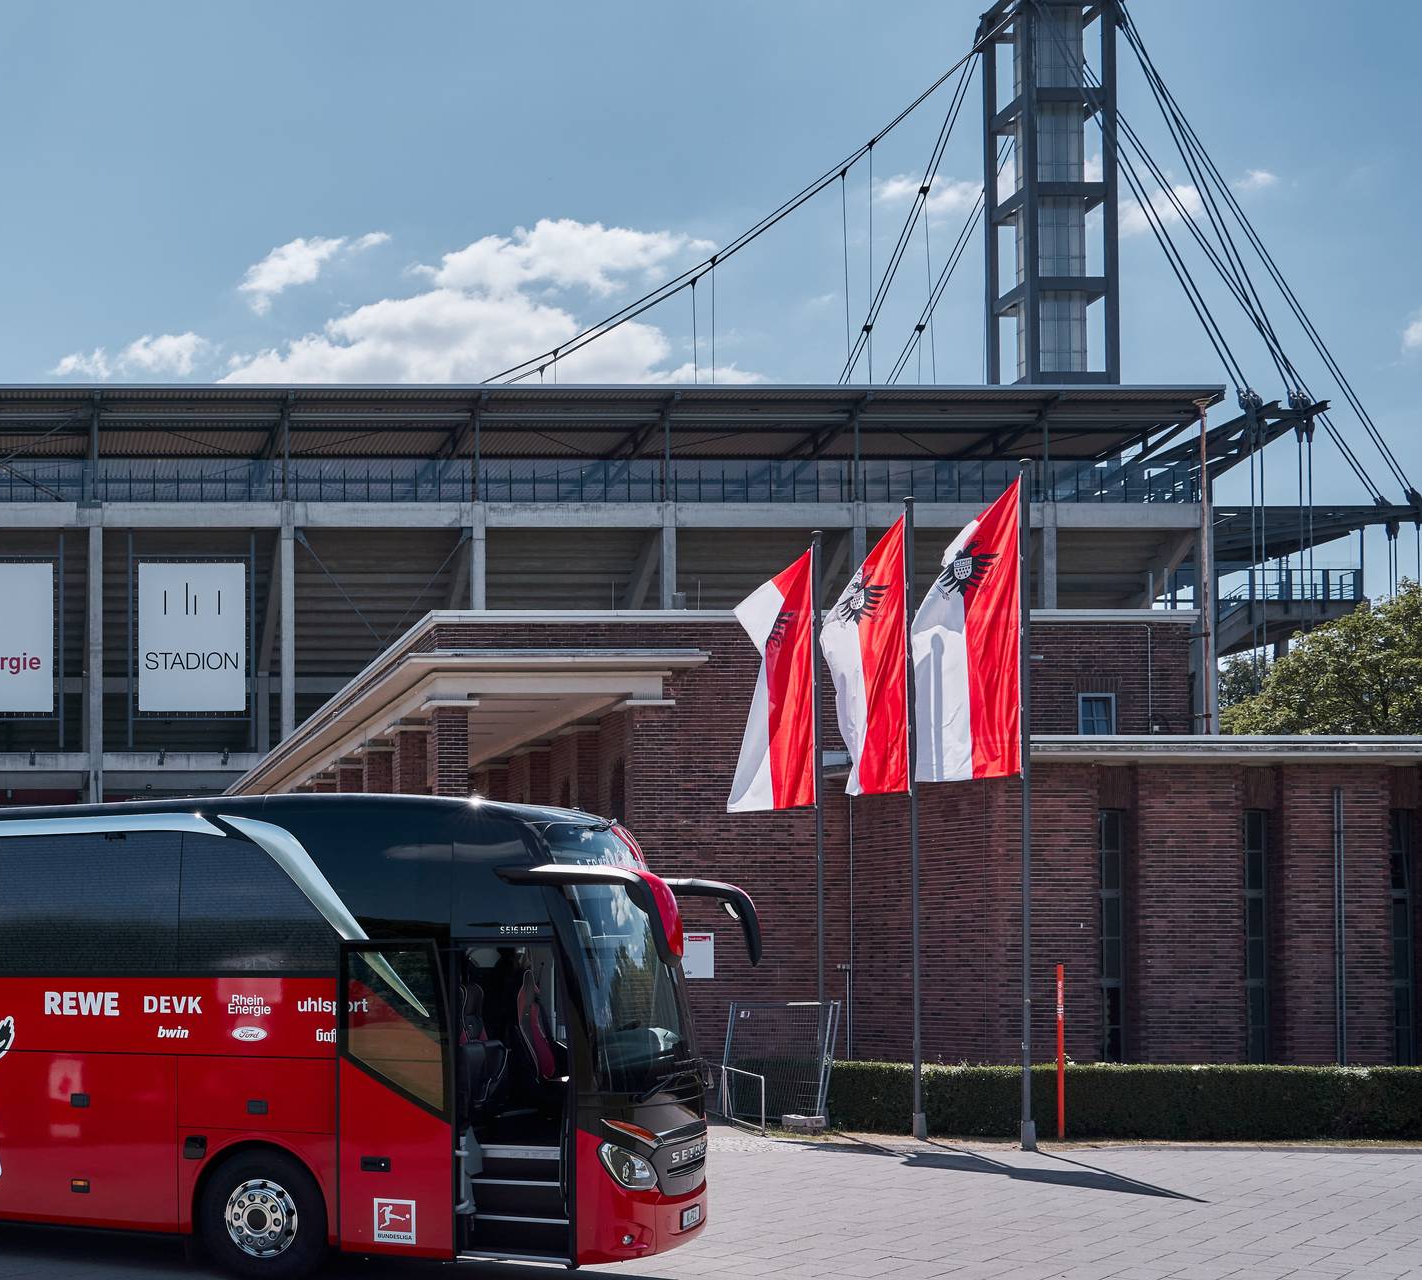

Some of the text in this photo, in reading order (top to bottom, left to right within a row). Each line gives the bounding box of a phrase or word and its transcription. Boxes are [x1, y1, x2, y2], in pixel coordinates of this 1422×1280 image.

[144, 652, 239, 671] STADION
[44, 991, 120, 1016] REWE
[143, 995, 202, 1014] DEVK
[232, 994, 264, 1005] Rhein
[228, 1003, 271, 1017] Energie
[157, 1025, 189, 1039] bwin
[238, 1029, 260, 1039] Ford
[377, 1232, 413, 1241] BUNDESLIGA
